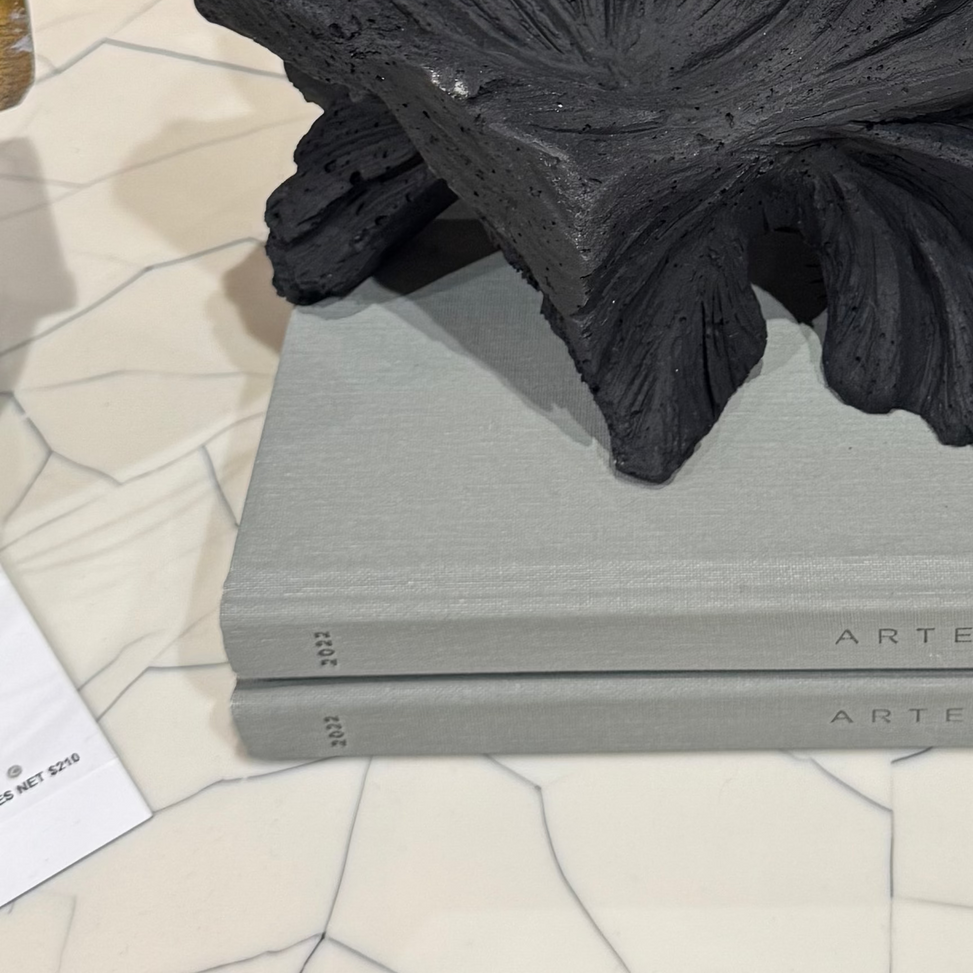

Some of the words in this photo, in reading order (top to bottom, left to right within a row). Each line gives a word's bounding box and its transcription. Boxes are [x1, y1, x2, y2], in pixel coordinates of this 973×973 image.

[314, 631, 338, 667] 2022
[323, 715, 347, 747] 2022
[16, 771, 45, 794] NET
[48, 752, 81, 776] $210
